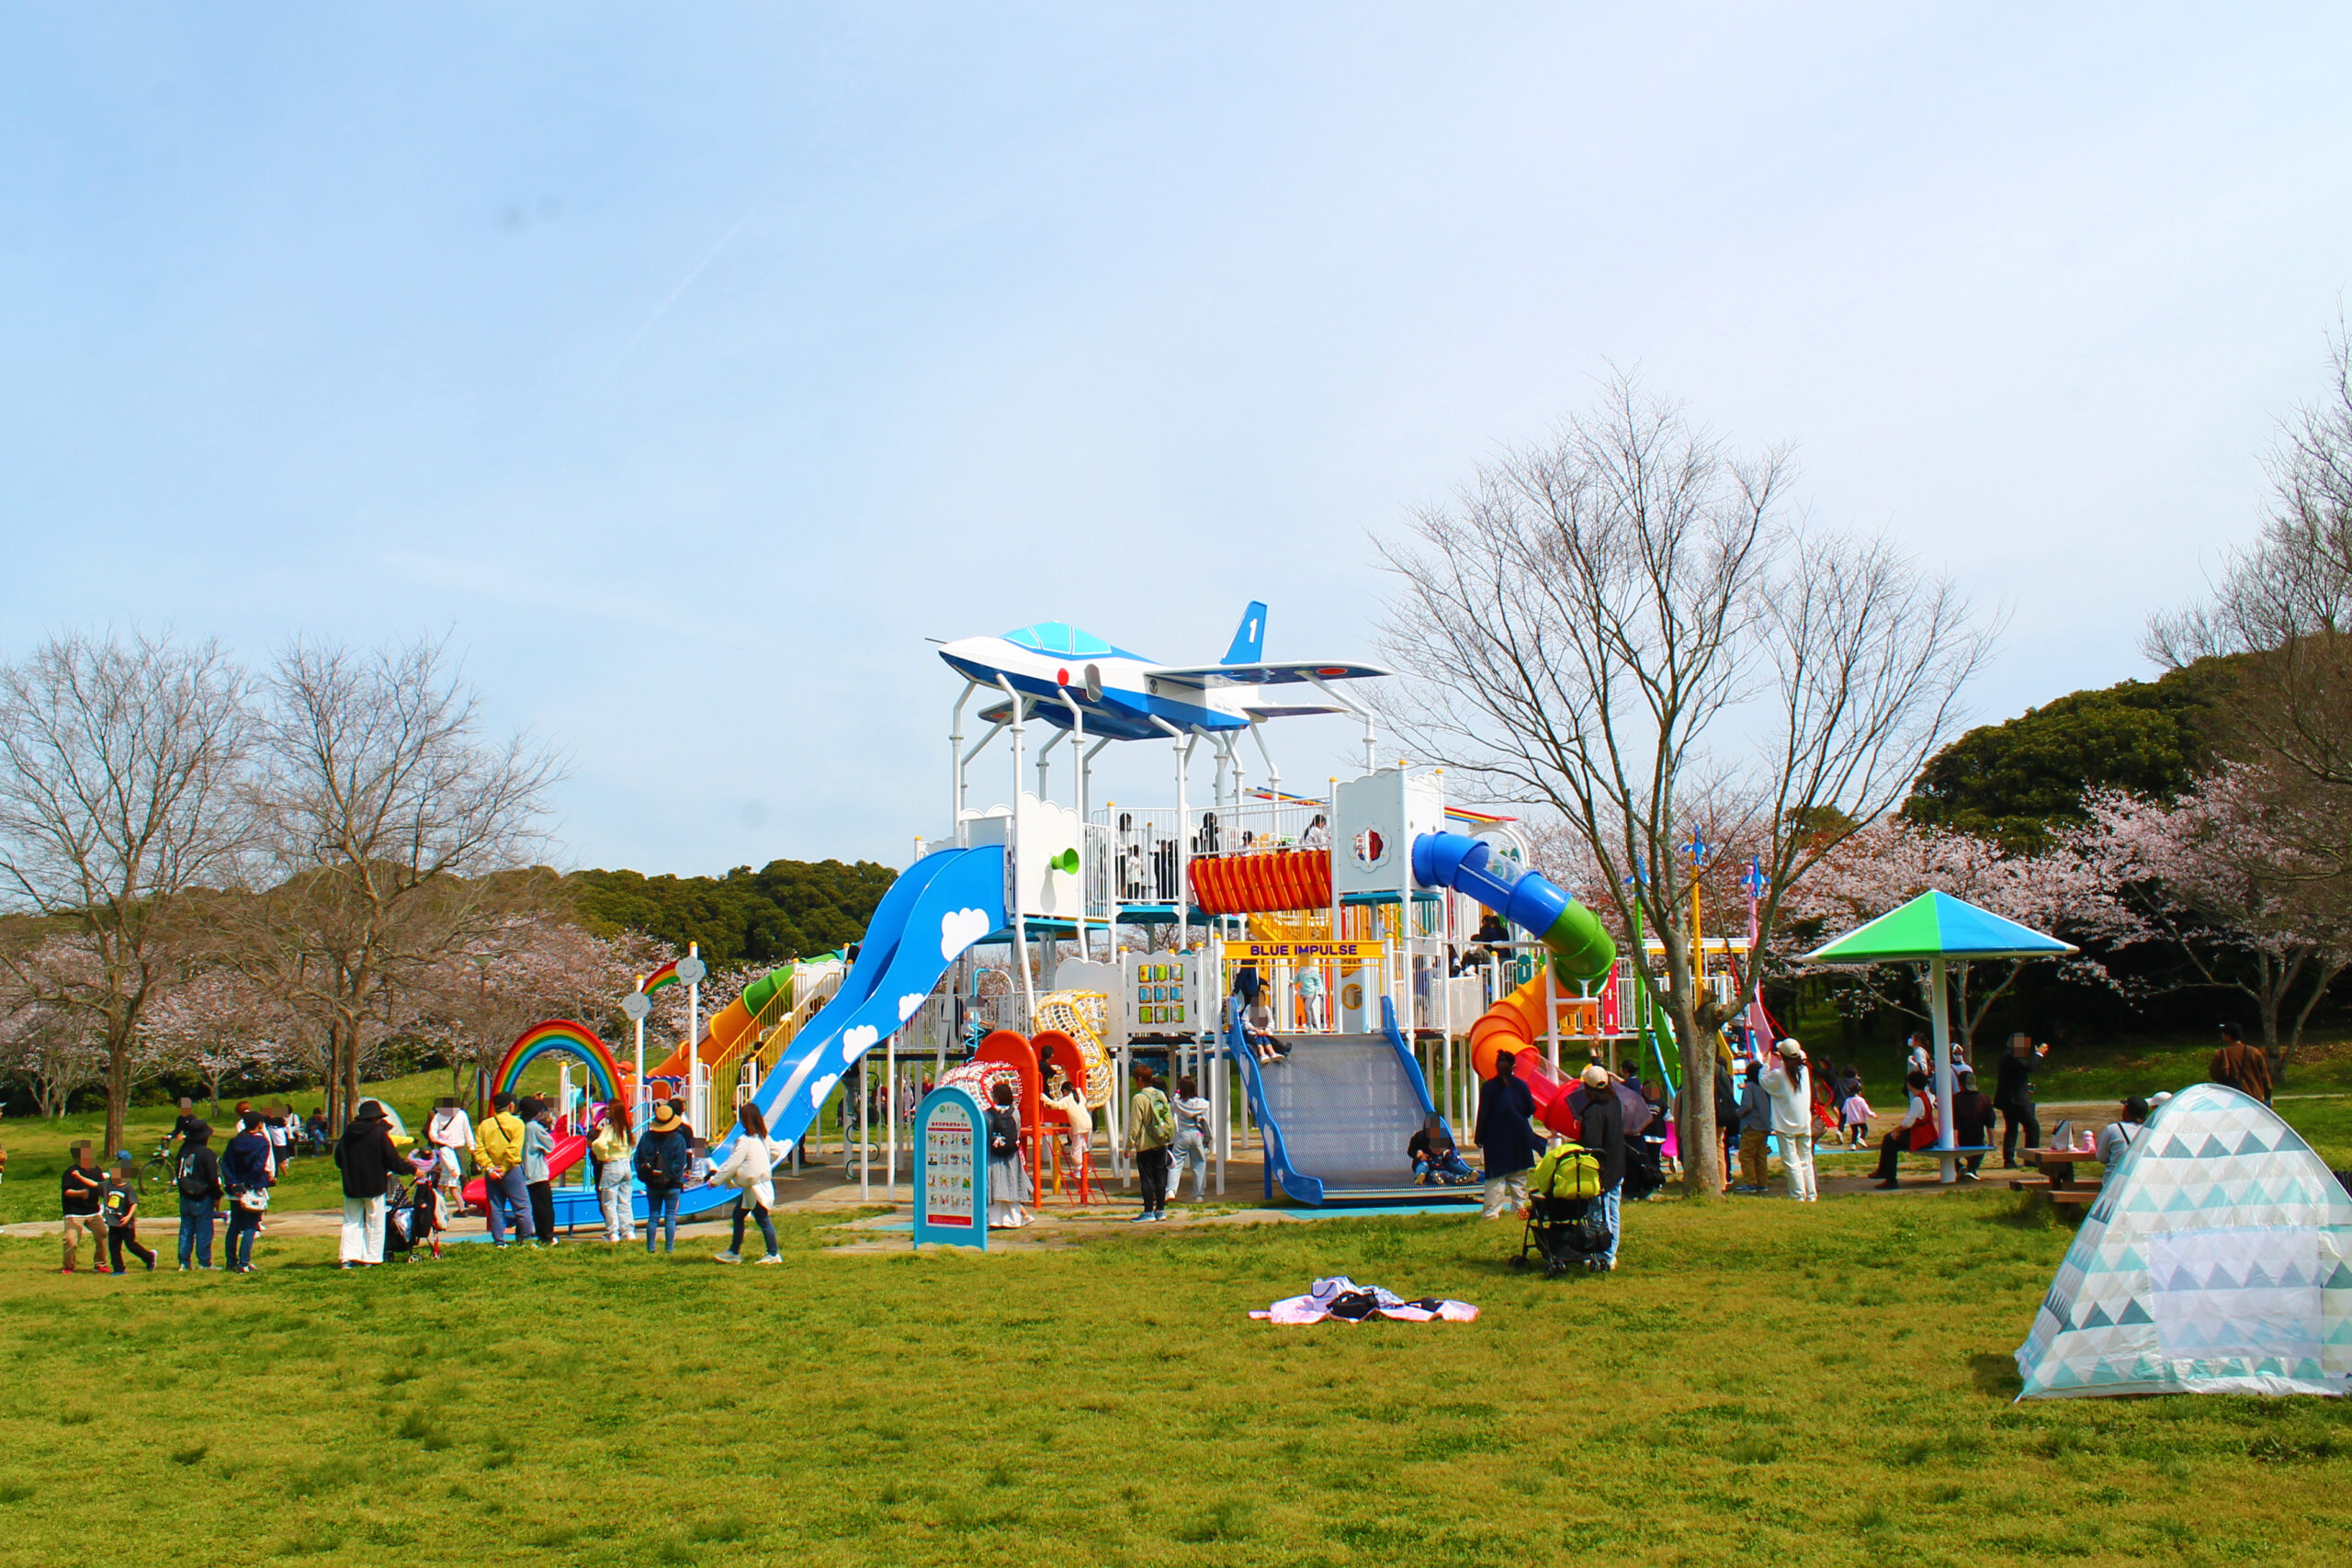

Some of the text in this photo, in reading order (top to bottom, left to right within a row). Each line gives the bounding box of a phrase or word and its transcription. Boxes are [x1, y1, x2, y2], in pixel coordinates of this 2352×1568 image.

[1250, 618, 1258, 643] 1
[1250, 945, 1357, 955] BLUE IMPULSE
